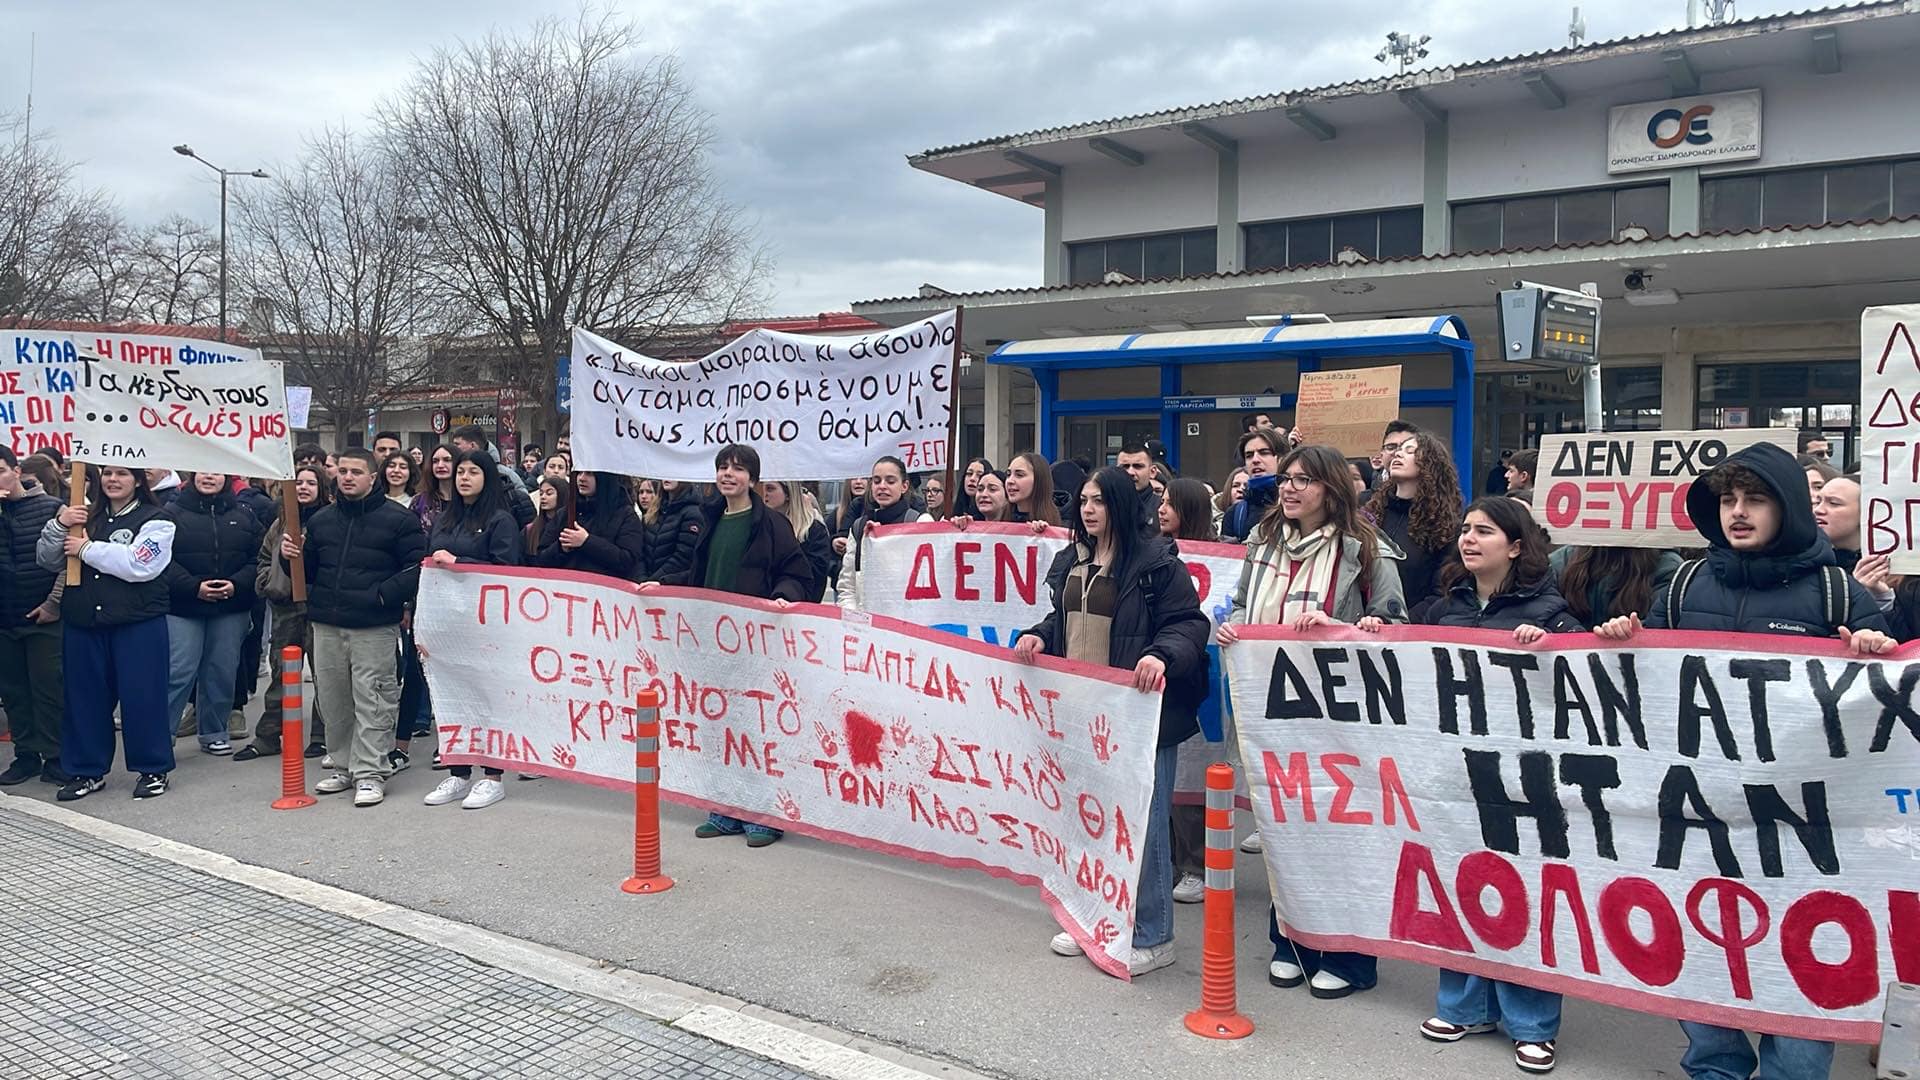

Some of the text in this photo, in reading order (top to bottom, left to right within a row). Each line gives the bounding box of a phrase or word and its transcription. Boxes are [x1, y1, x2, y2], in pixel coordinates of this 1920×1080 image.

[1719, 144, 1757, 154] ΕΛΛΑΔΟΣ
[816, 344, 834, 362] κι
[79, 356, 122, 392] Τα
[129, 370, 210, 406] κέρδη
[213, 384, 269, 407] τους
[101, 443, 146, 458] ΕΠΑΛ
[168, 404, 242, 437] ζωές
[249, 412, 286, 452] μας
[703, 412, 798, 445] κάποιο
[1551, 440, 1634, 477] ΔΕΝ
[904, 542, 1037, 605] ΔΕΝ
[1775, 622, 1806, 632] Columbia
[479, 584, 699, 646] ΠΟΤΑΜΙΑ
[715, 615, 824, 665] ΟΡΓΗΣ
[843, 634, 968, 704] ΕΛΠΙΔΑ
[989, 675, 1064, 740] ΚΑΙ
[1265, 646, 1406, 725] ΔΕΝ
[1433, 647, 1649, 750] ΗΤΑΝ
[568, 699, 702, 752] ΚΡΙΕΙ
[724, 727, 785, 778] ΜΕ
[989, 813, 1068, 875] ΣΤΟΝ
[745, 690, 802, 736] ΤΟ
[929, 735, 1063, 811] ΔΙΚΙΟ
[1077, 792, 1134, 863] ΘΑ
[1262, 750, 1421, 832] ΜΣΛ
[1463, 747, 1840, 878] ΗΤΑΝ
